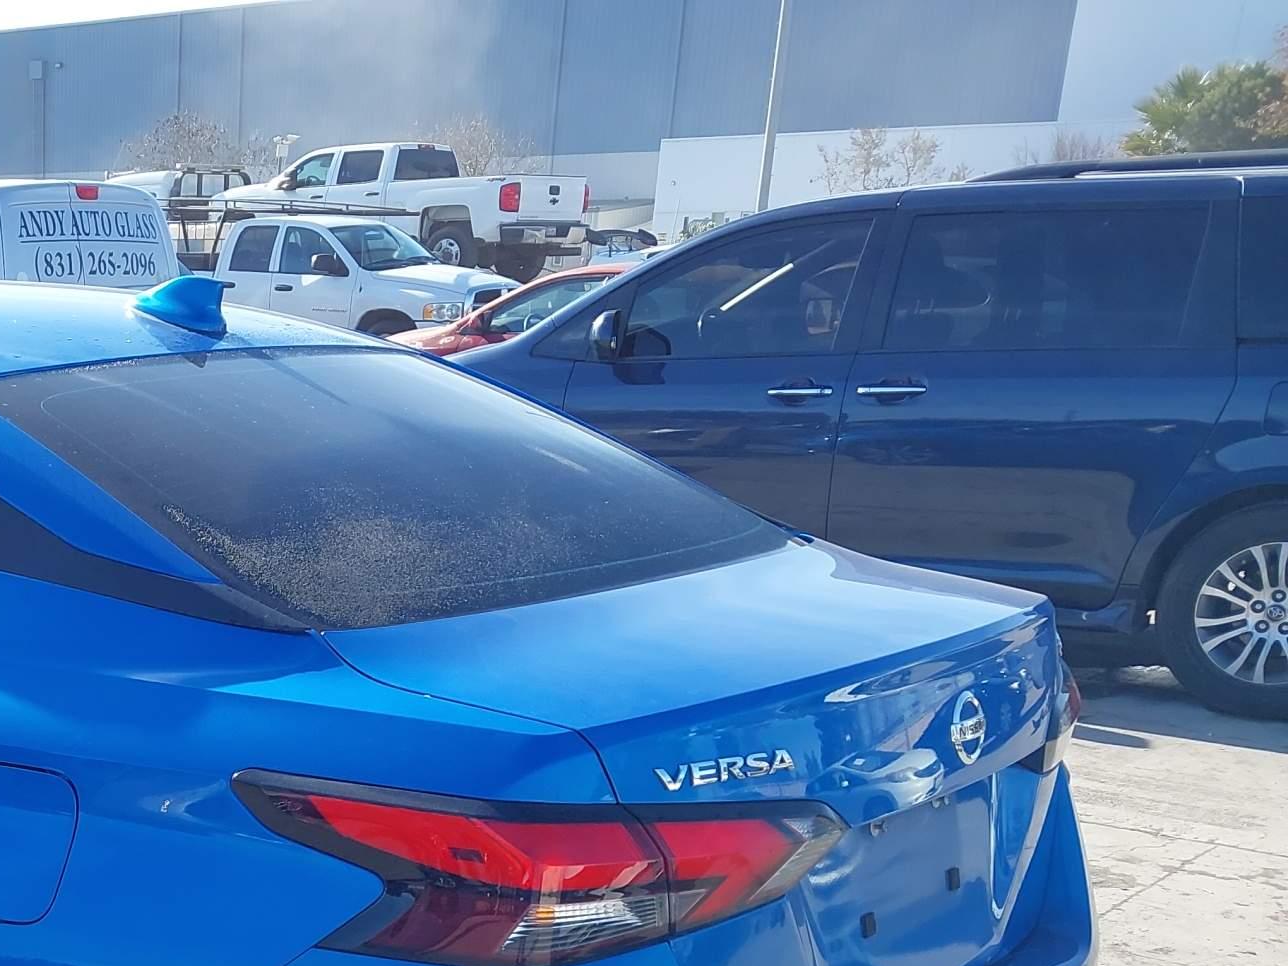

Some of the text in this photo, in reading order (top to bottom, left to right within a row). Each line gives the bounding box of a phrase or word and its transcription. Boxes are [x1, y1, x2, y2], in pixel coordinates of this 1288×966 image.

[18, 210, 158, 240] ANDY AUTO GLASS
[34, 245, 157, 283] (831) 265-2096
[654, 748, 795, 792] VERSA
